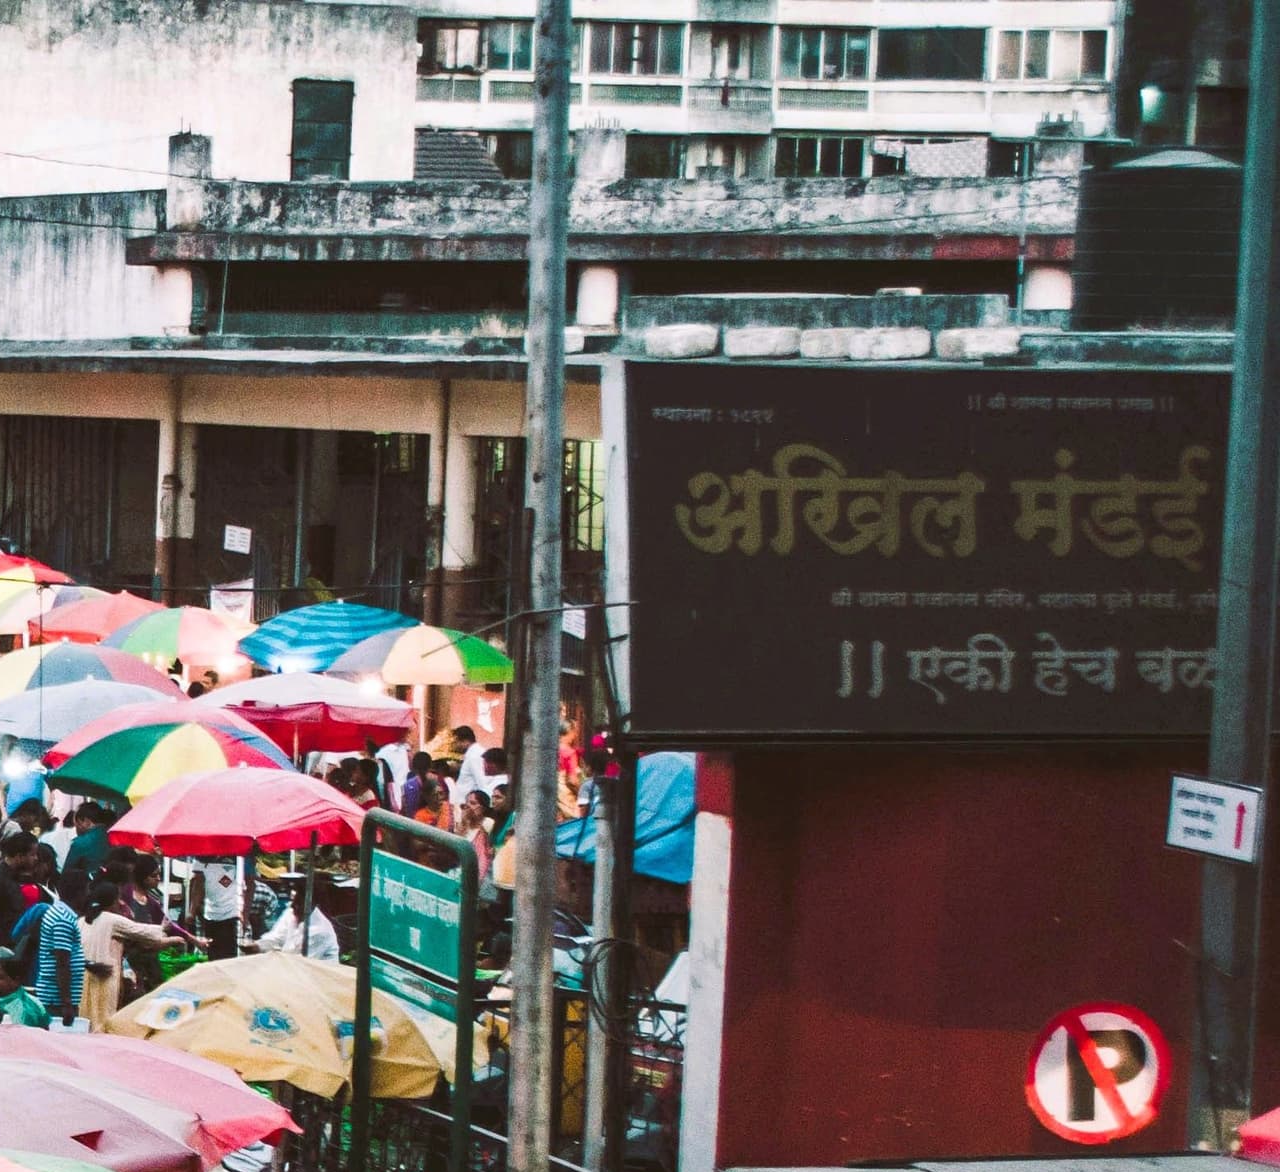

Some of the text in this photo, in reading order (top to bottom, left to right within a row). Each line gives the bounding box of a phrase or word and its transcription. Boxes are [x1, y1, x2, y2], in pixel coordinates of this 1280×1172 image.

[674, 443, 1213, 572] अखिल मंडई
[906, 634, 1017, 703] एकी
[1033, 632, 1120, 698] हेच
